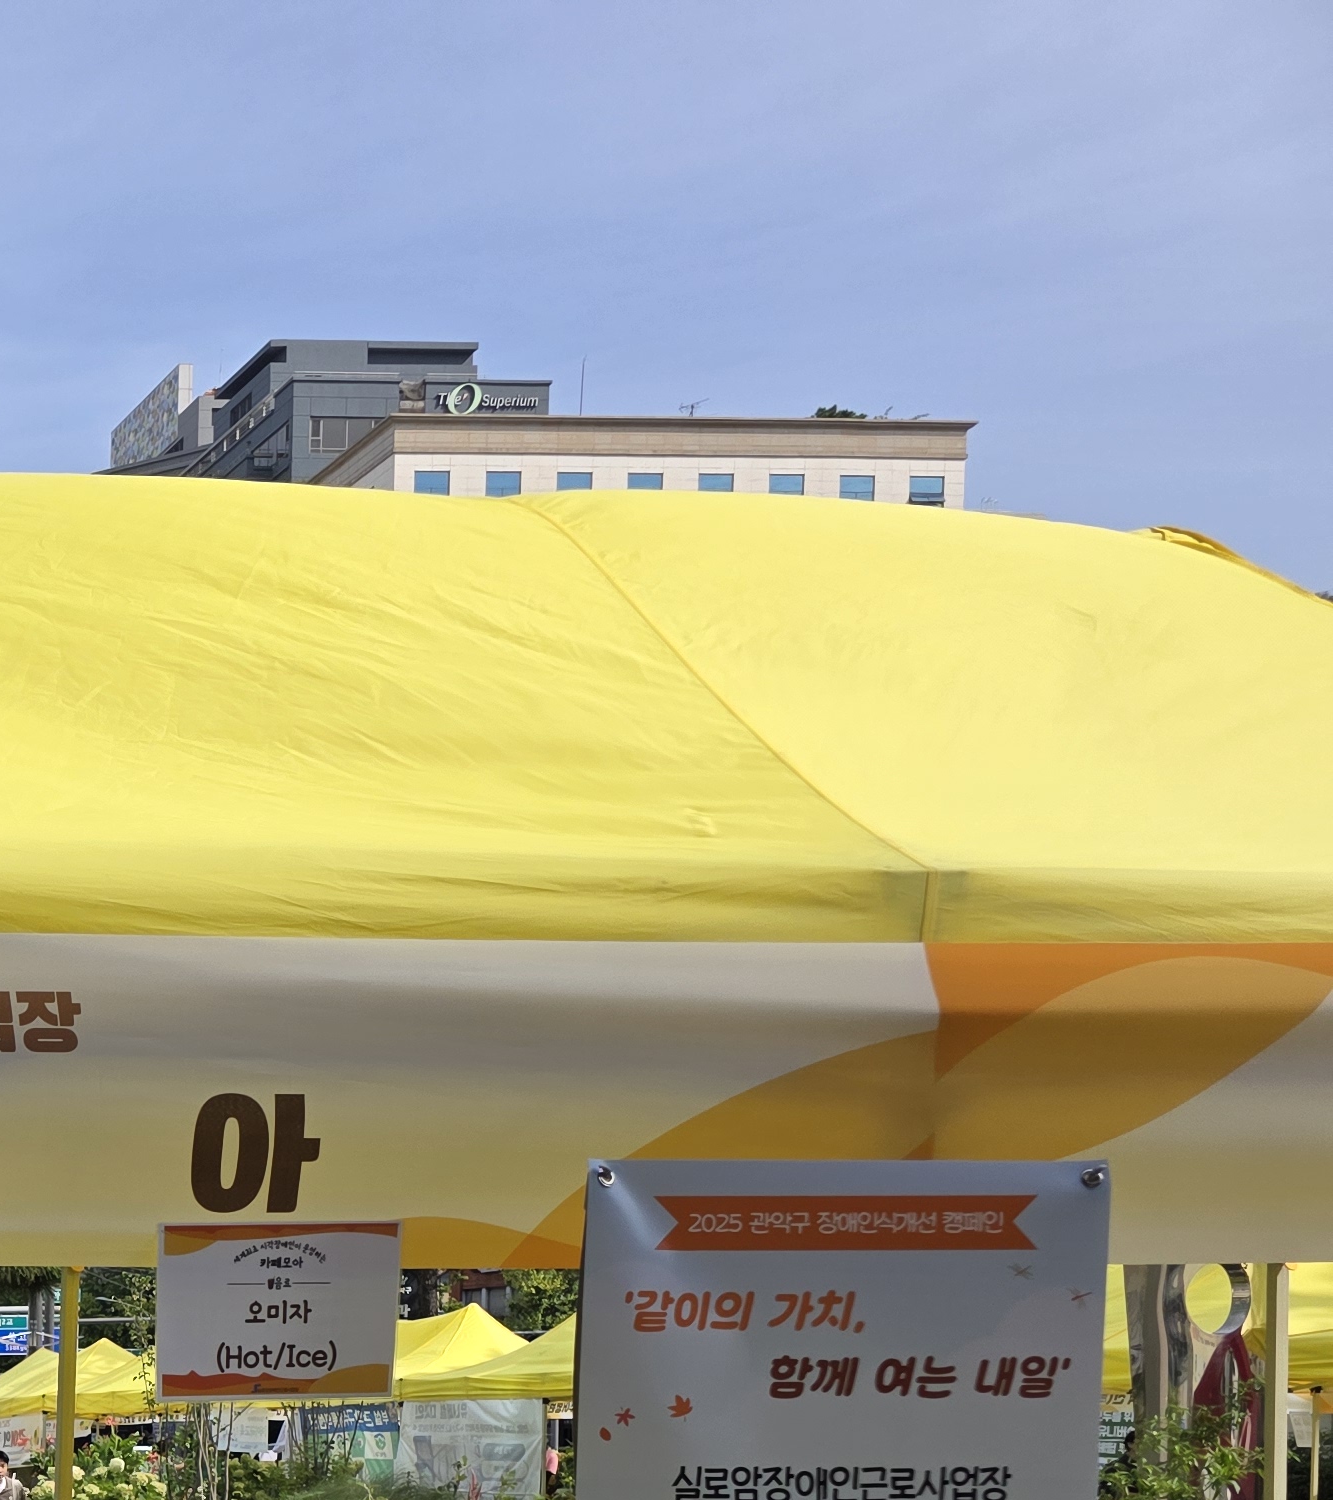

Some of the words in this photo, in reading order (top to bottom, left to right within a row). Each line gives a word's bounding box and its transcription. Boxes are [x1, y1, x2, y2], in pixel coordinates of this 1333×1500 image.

[482, 394, 538, 408] Superium
[688, 1212, 743, 1234] 2025
[749, 1212, 810, 1234] 관악구
[816, 1212, 937, 1234] 장애인식개선
[260, 1256, 303, 1269] 카페모아
[245, 1300, 312, 1324] 오미자
[768, 1290, 866, 1334] 가치,
[216, 1340, 337, 1373] (Hot/Ice)
[769, 1356, 860, 1399] 함께
[874, 1356, 958, 1399] 여는
